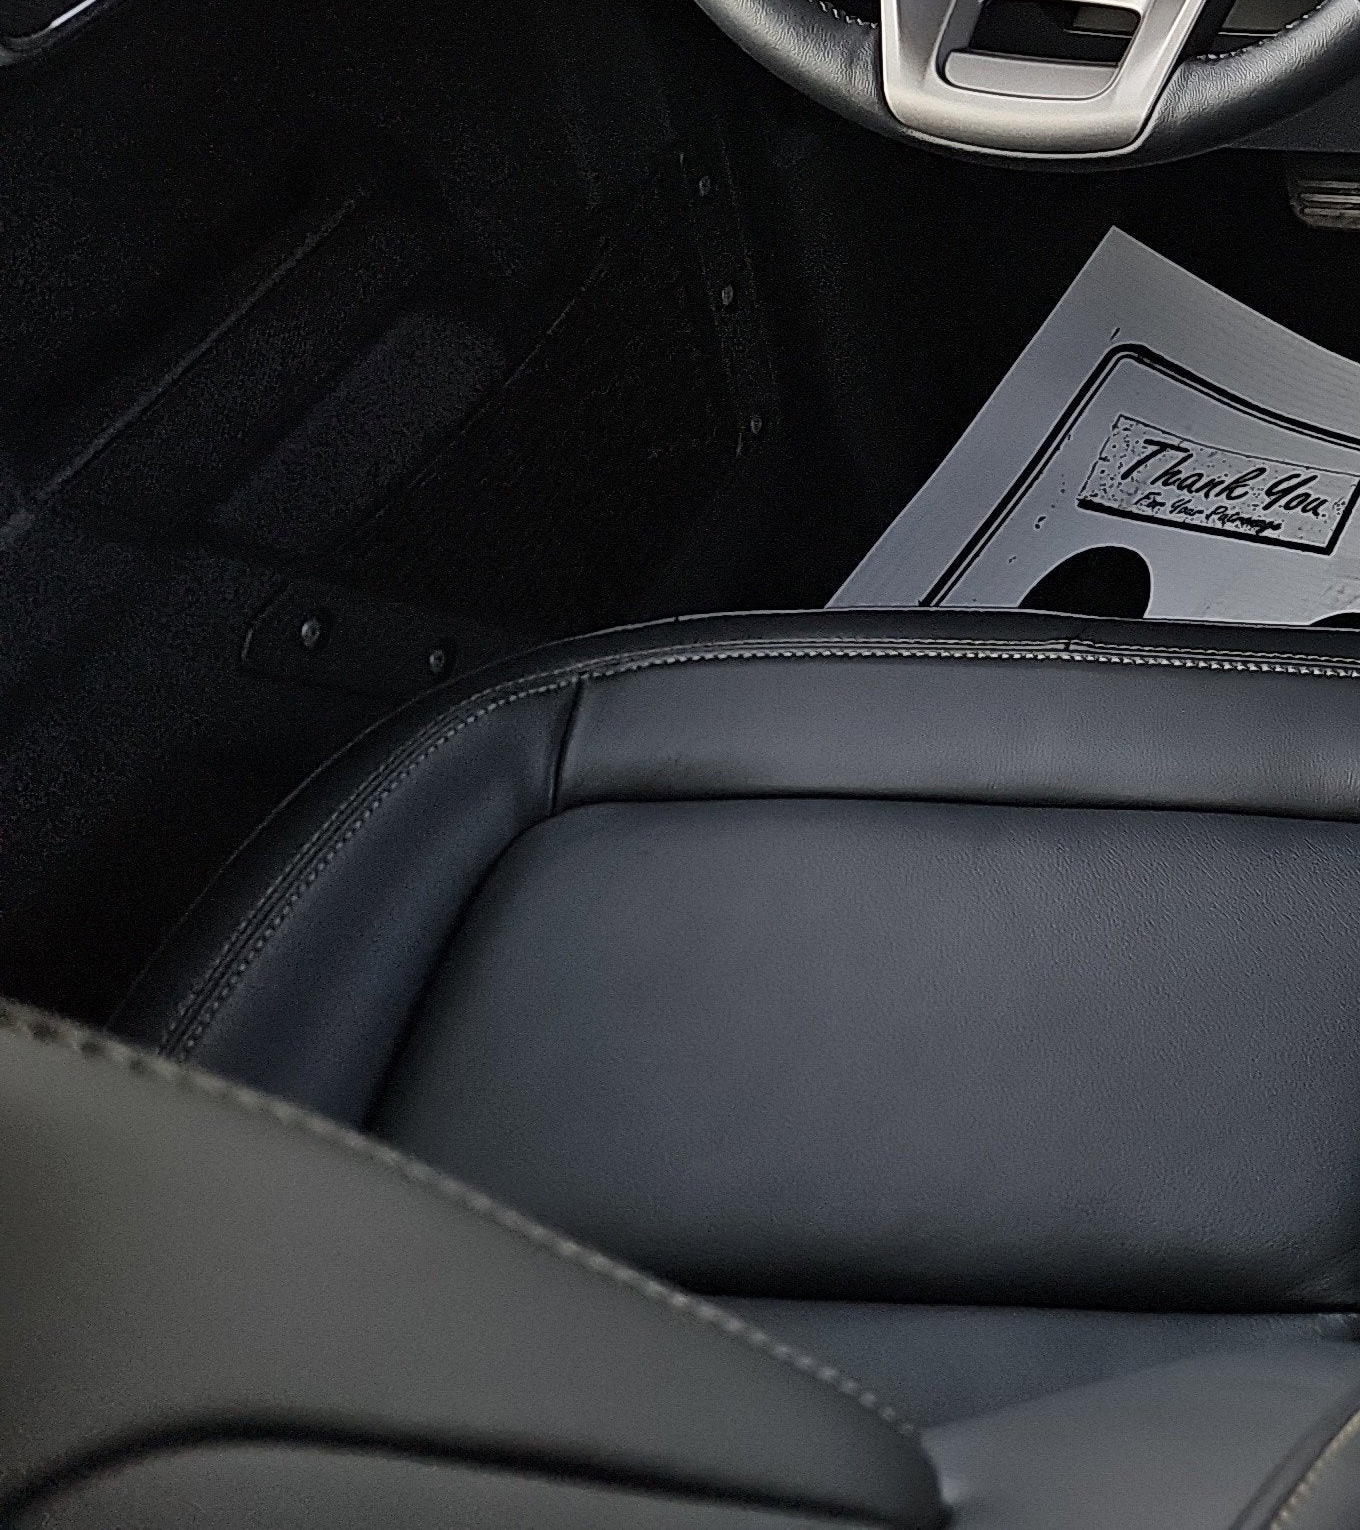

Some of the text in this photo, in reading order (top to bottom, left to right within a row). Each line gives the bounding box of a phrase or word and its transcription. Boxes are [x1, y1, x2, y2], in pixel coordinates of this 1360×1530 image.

[1121, 438, 1328, 519] Thank You
[1133, 491, 1165, 510] For
[1169, 493, 1204, 519] Your
